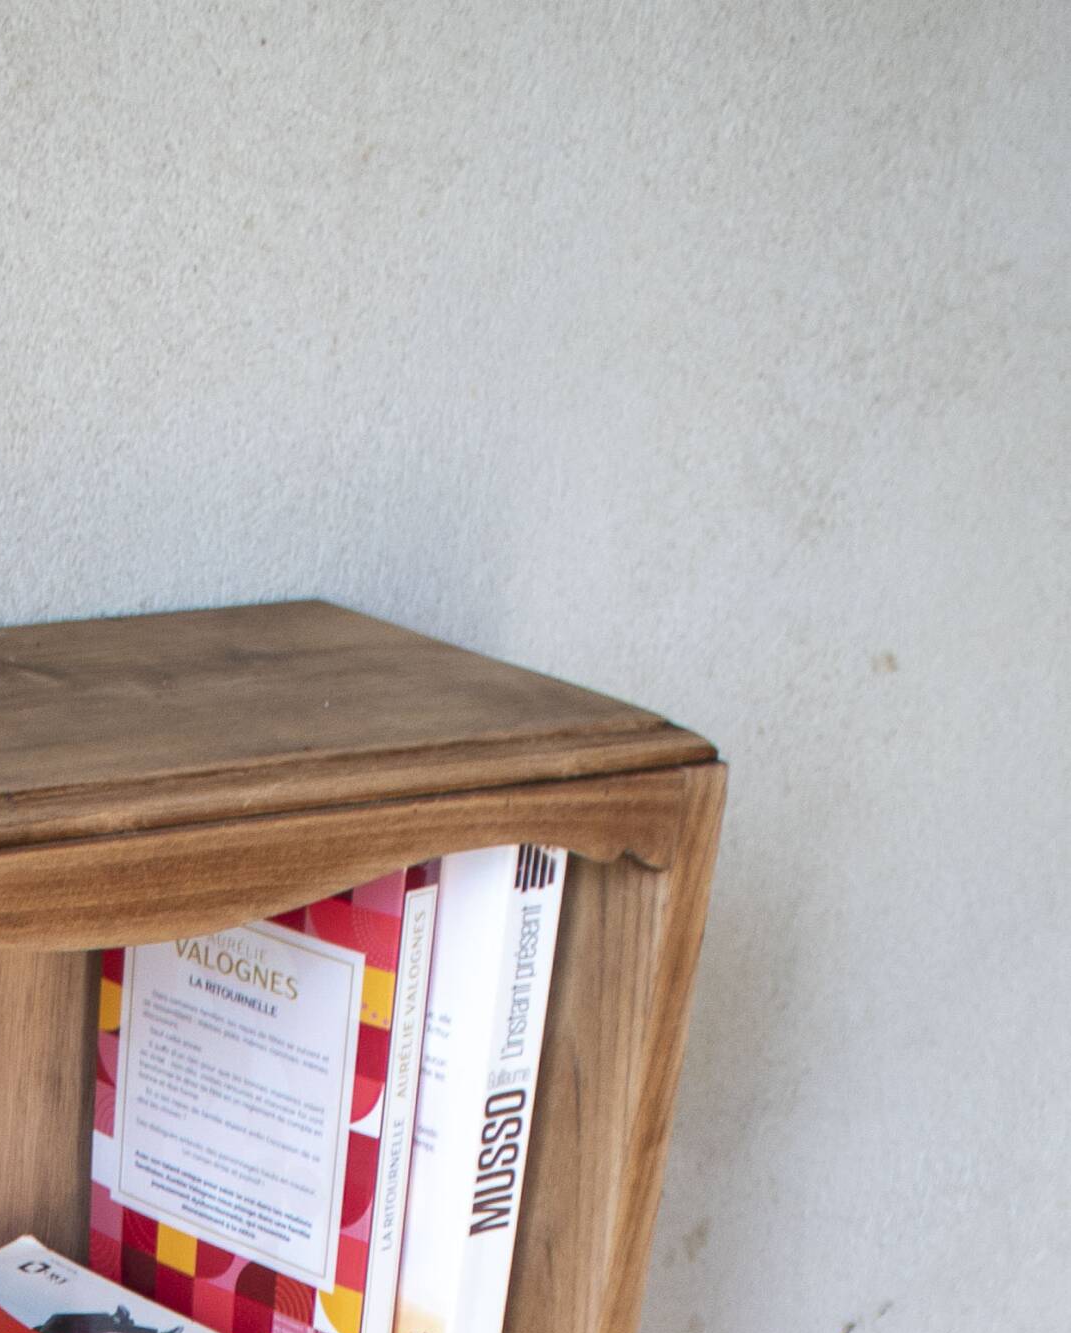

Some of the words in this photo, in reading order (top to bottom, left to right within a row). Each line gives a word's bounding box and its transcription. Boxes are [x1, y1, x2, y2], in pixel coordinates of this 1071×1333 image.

[175, 939, 299, 1000] VALOGNES
[189, 974, 202, 989] LA
[205, 979, 278, 1018] RITOURNELLE
[405, 911, 426, 1016] VALOGNES
[397, 1022, 414, 1098] AURÉLIE
[384, 1120, 404, 1228] RITOURNELLE
[469, 1089, 526, 1237] MUSSO
[382, 1231, 393, 1251] LA
